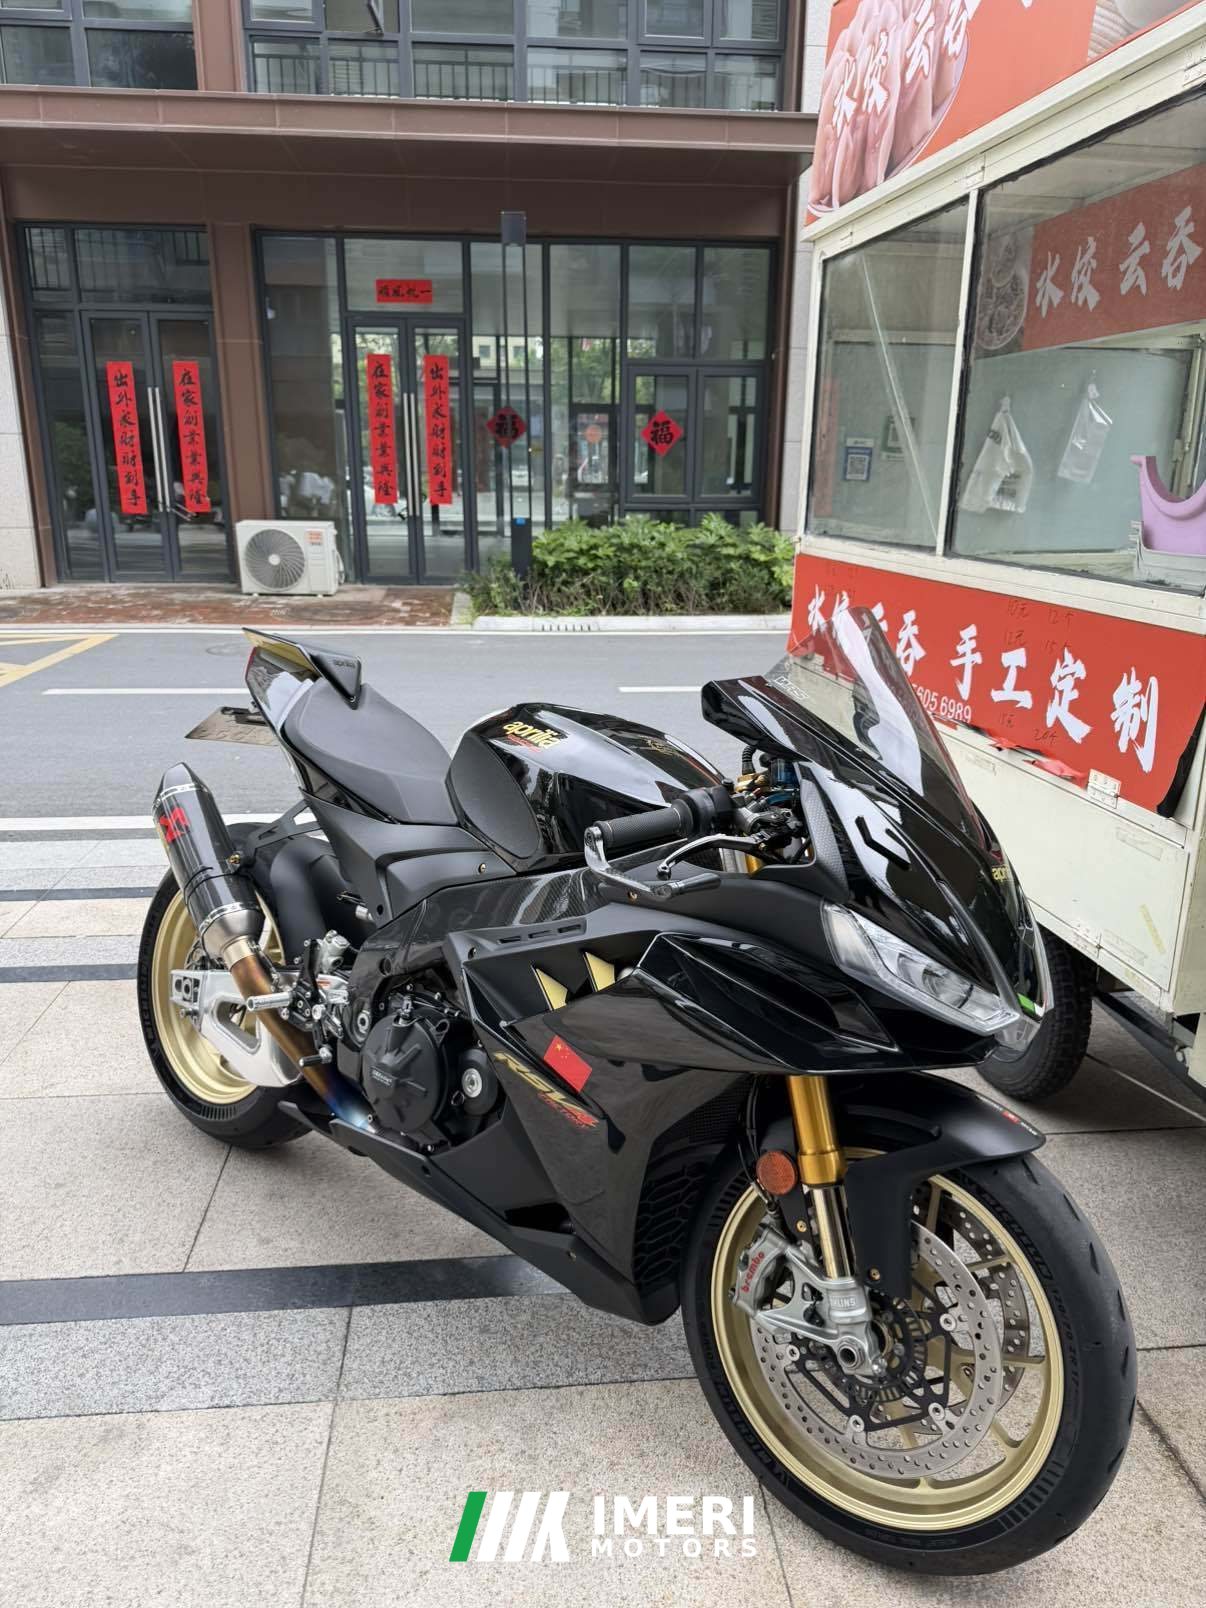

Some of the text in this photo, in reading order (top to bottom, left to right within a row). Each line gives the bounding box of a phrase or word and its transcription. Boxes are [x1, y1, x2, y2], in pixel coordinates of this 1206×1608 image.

[1036, 205, 1204, 318] 水饺云吞
[650, 419, 674, 446] 福
[502, 720, 563, 749] aprilia
[740, 1250, 766, 1294] brembo
